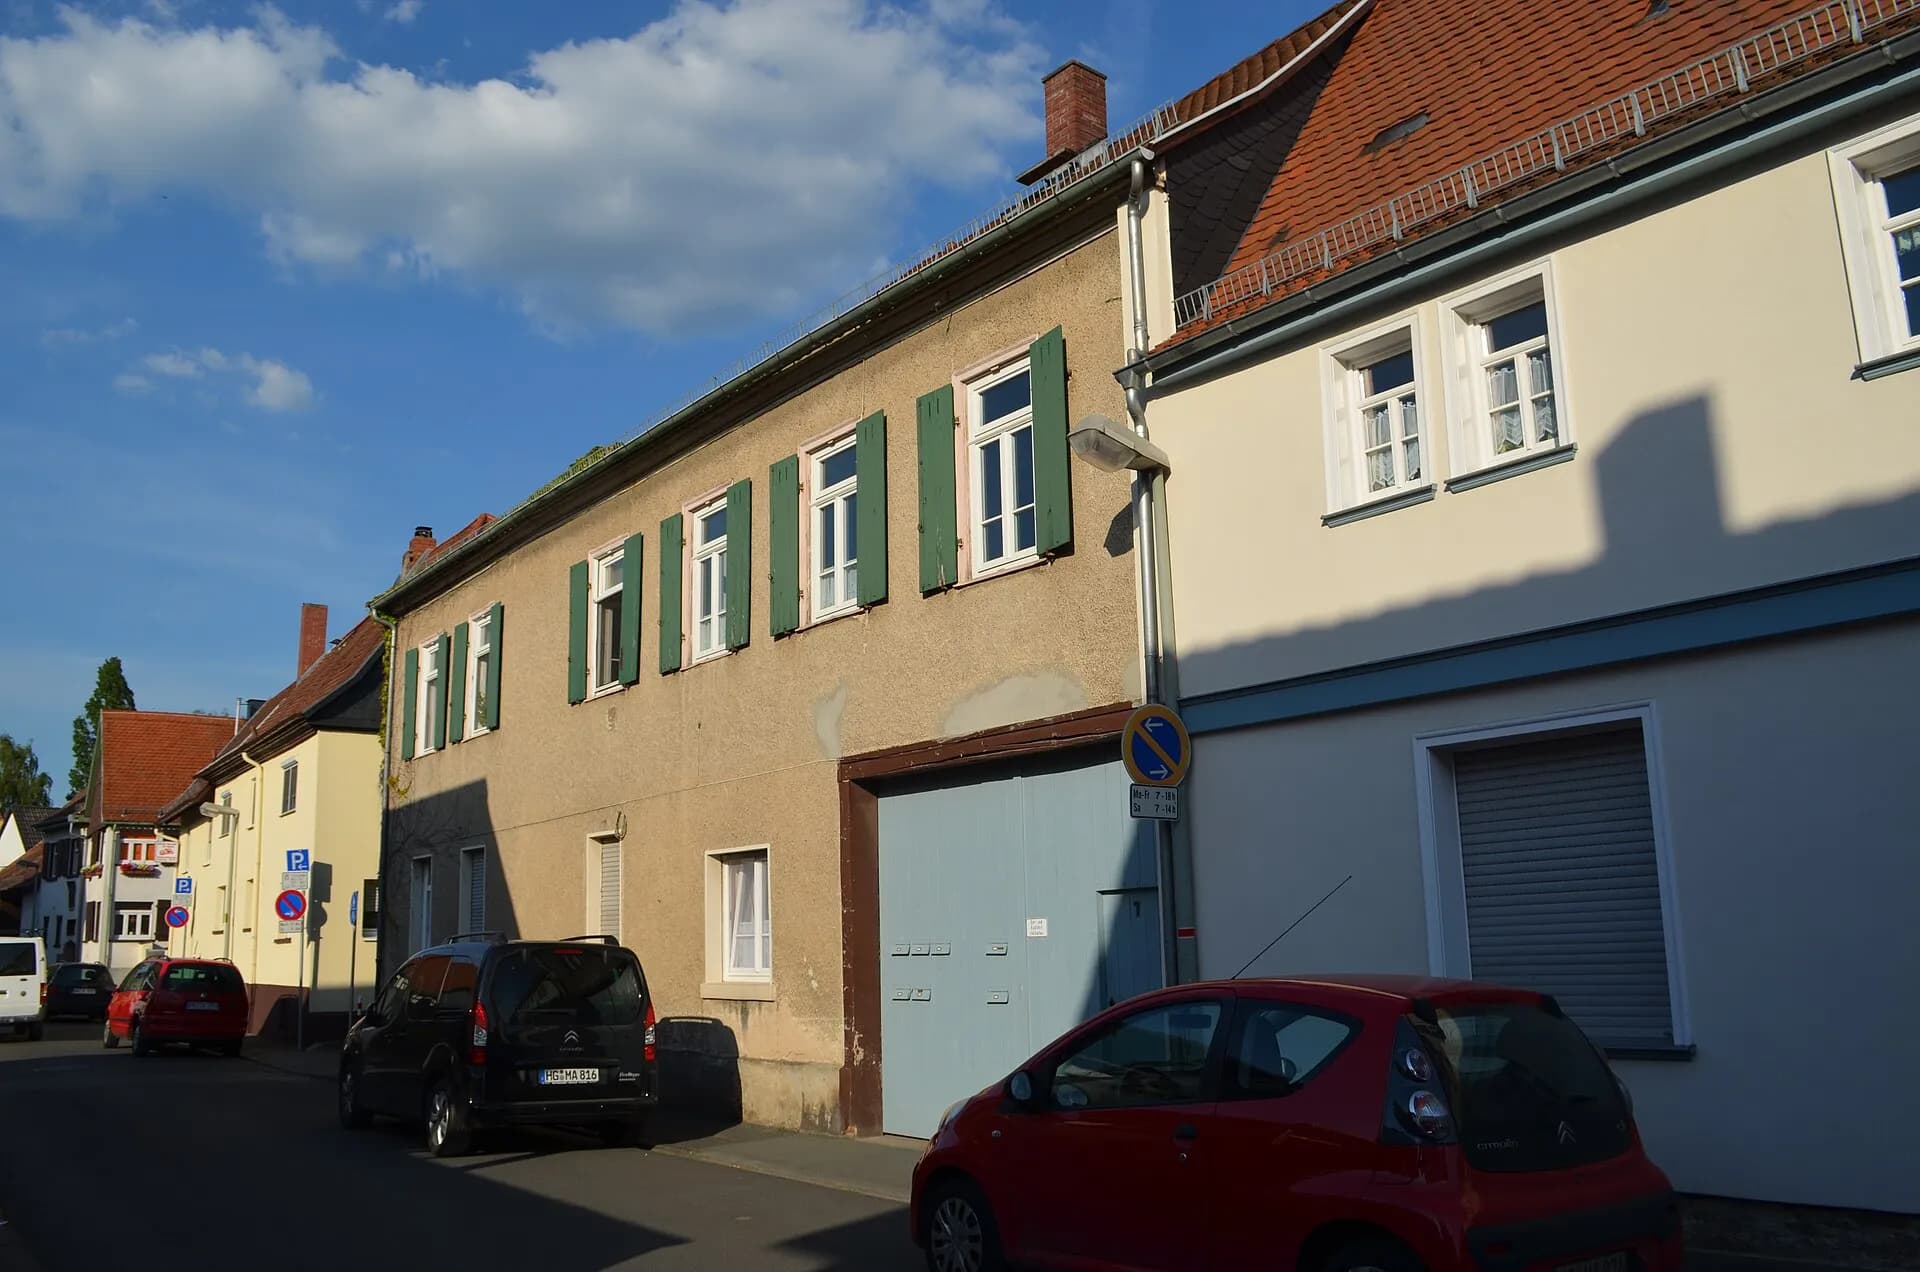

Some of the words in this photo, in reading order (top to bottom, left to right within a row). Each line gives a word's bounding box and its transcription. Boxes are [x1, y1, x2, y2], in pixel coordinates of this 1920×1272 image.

[291, 852, 305, 870] P
[179, 879, 189, 892] P
[546, 1070, 559, 1081] HG
[565, 1070, 577, 1080] MA
[580, 1070, 597, 1080] 816
